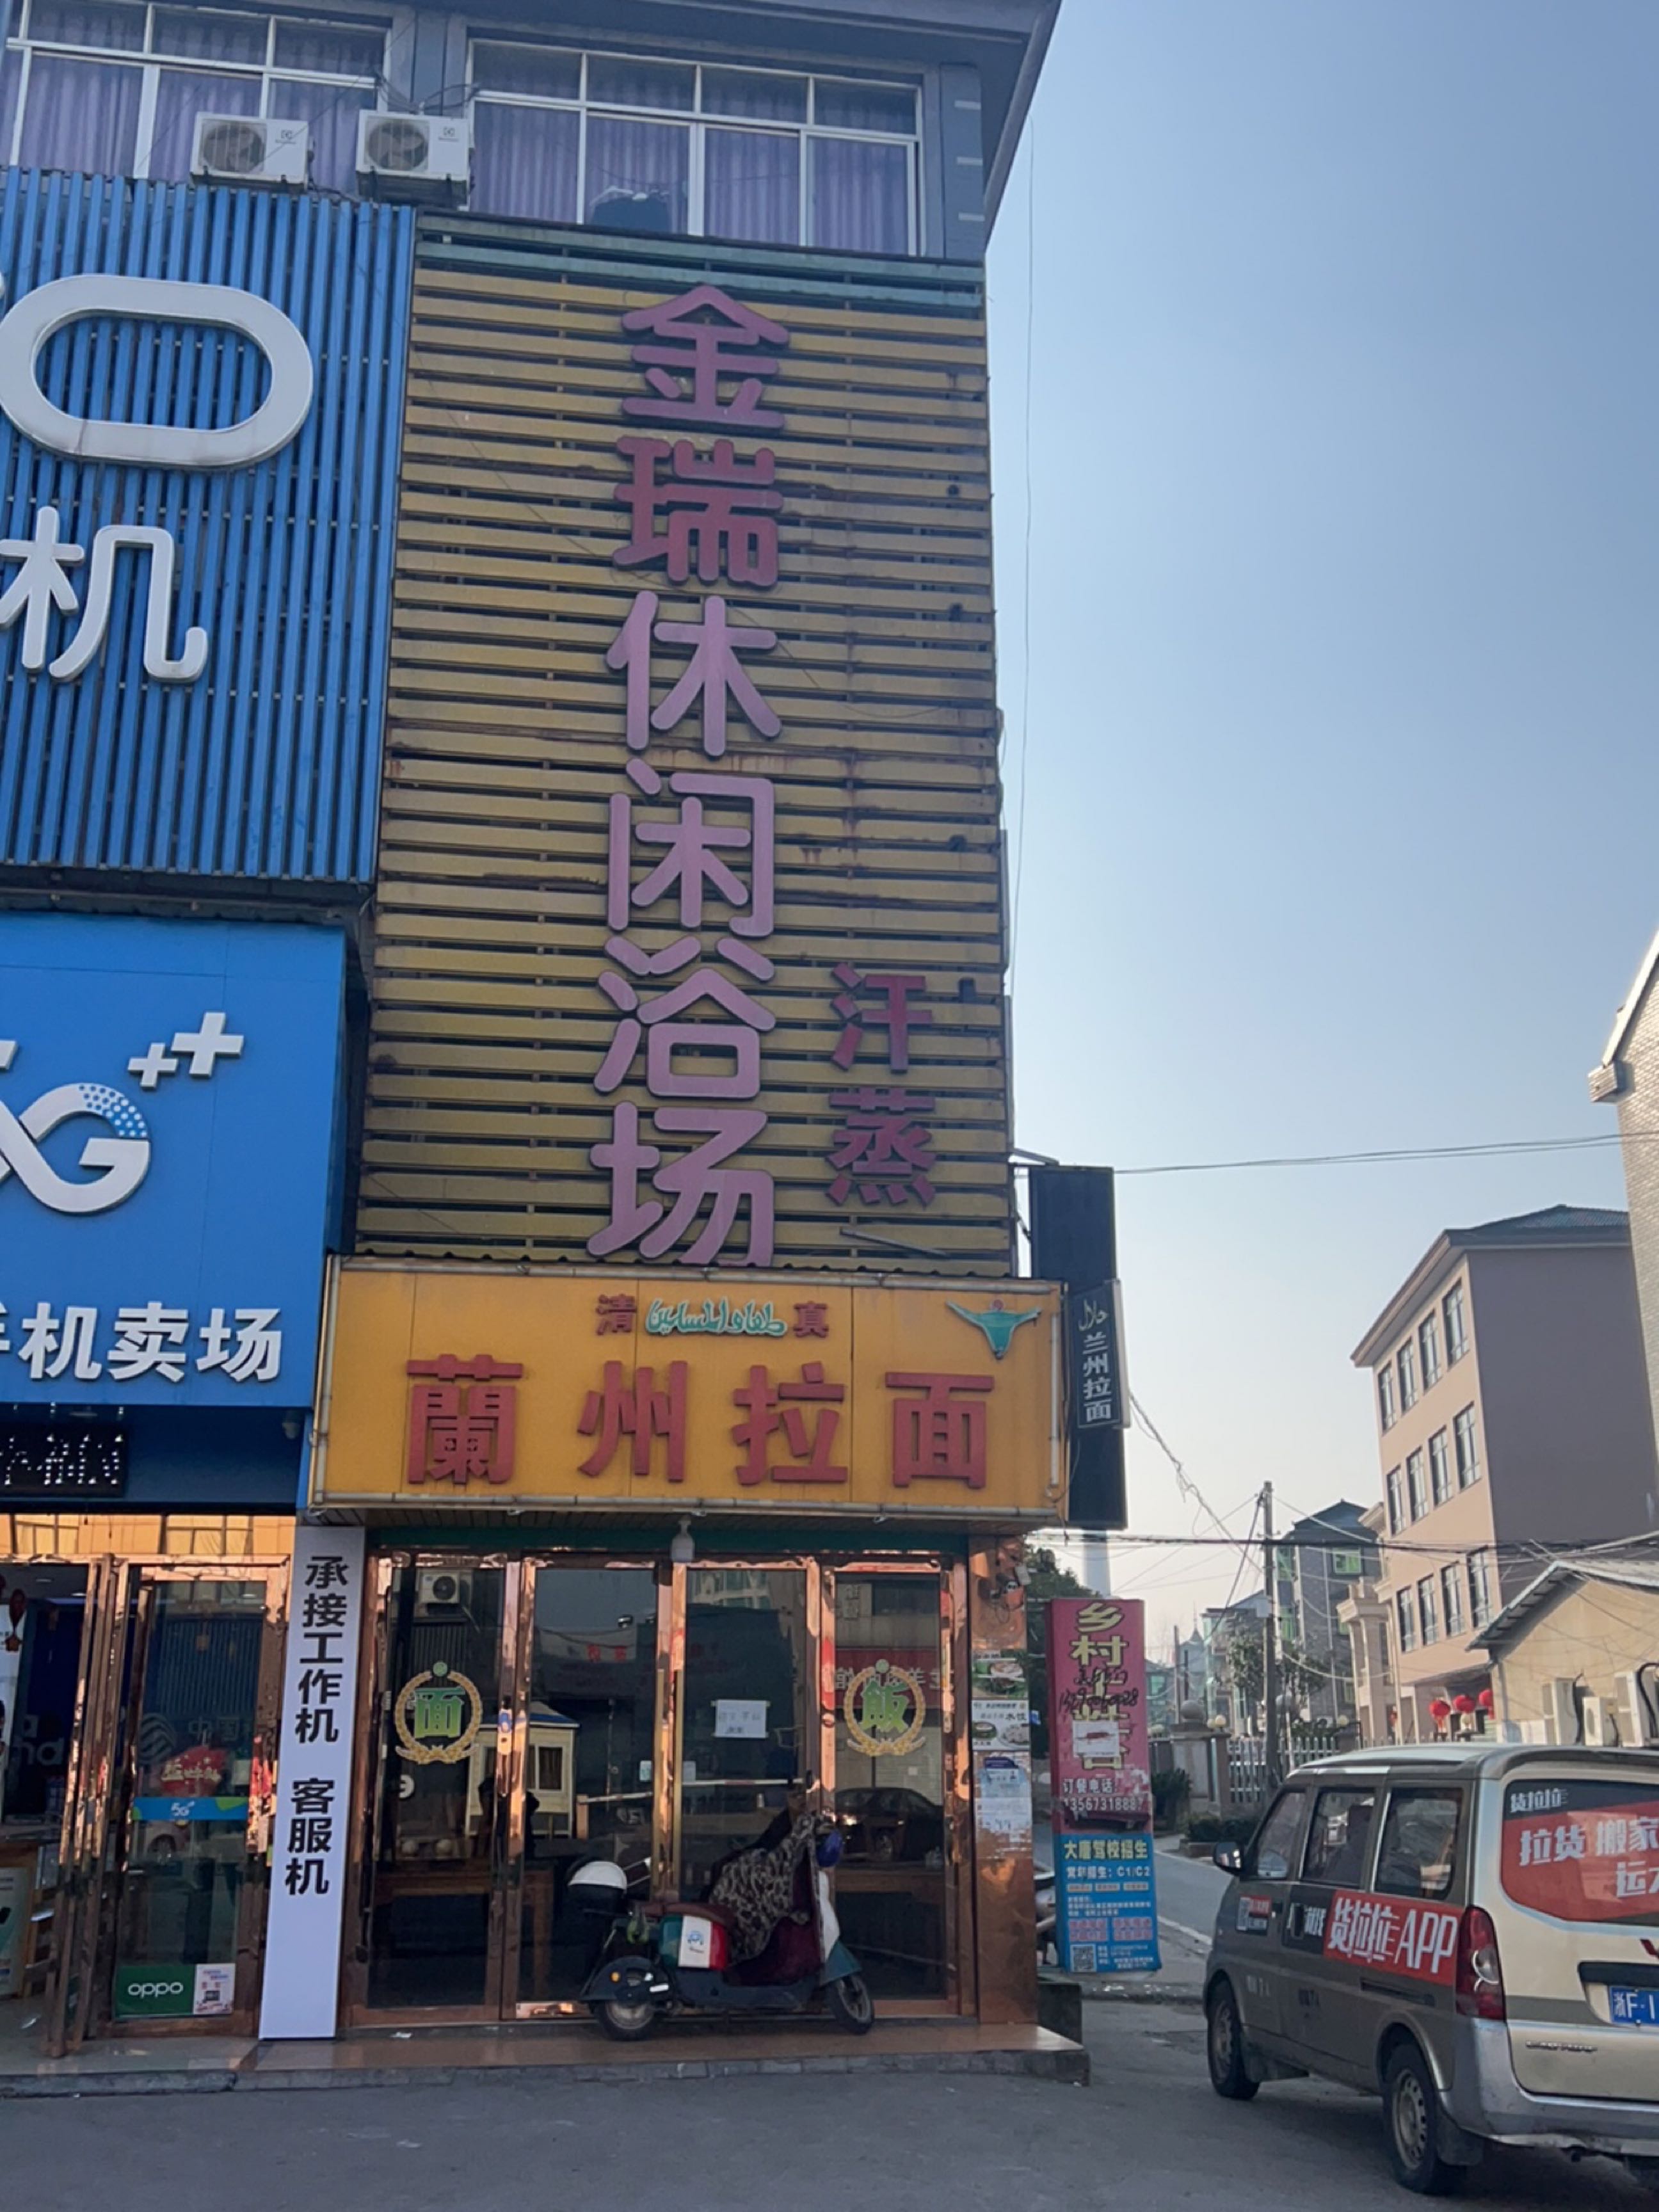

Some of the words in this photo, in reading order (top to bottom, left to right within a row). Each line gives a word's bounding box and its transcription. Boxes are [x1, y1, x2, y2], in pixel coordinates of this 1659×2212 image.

[587, 285, 789, 1267] 金瑞休闲浴场
[825, 962, 936, 1207] 汗蒸
[0, 1301, 282, 1383] 机卖场
[1082, 1333, 1112, 1423] 兰州拉面
[294, 1555, 349, 1744] 承接工作机
[284, 1777, 335, 1896] 客服机
